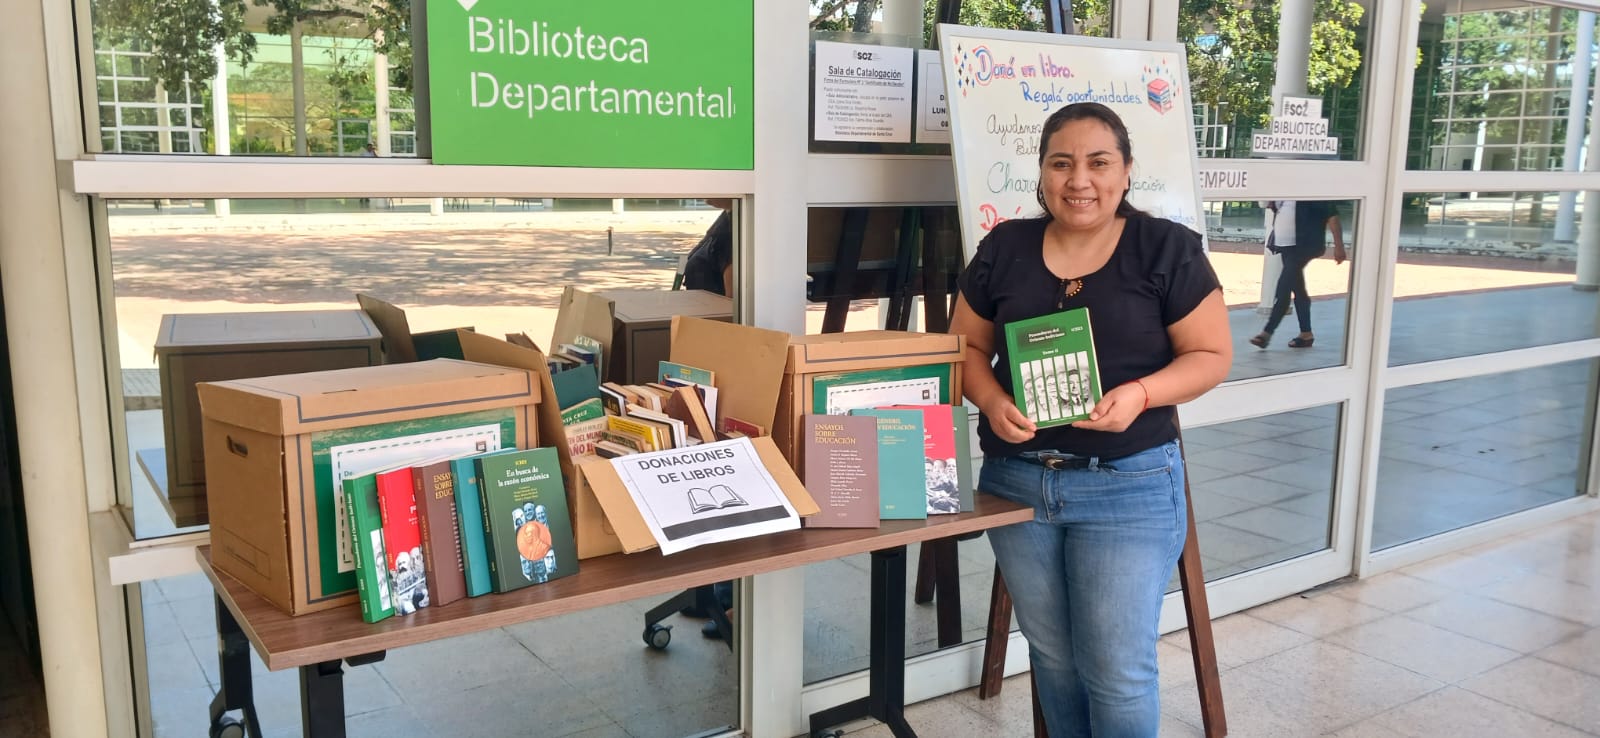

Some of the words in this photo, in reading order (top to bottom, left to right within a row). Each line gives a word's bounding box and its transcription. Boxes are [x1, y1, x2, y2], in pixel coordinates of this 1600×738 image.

[468, 16, 649, 63] Biblioteca
[828, 65, 844, 75] Sala
[845, 67, 855, 76] de
[856, 67, 902, 80] Catalogación
[972, 45, 1016, 86] Doná
[1039, 52, 1074, 79] libro.
[470, 71, 732, 118] Departamental
[1020, 81, 1064, 111] Regalá
[1274, 121, 1326, 136] BIBLIOTECA
[1255, 136, 1336, 152] DEPARTAMENTAL
[1200, 171, 1247, 188] EMPUJE
[1132, 176, 1166, 200] pción
[574, 410, 588, 419] CRUZ
[815, 423, 844, 431] ENSAYOS
[576, 434, 585, 442] DEL
[586, 430, 602, 440] MUN
[815, 437, 856, 445] EDUCACIÓN
[638, 448, 735, 470] DONACIONES
[433, 472, 452, 483] ENSAY
[506, 469, 515, 477] En
[515, 468, 531, 476] busca
[657, 472, 680, 484] DE
[681, 465, 735, 481] LIBROS
[436, 488, 453, 499] EDUC
